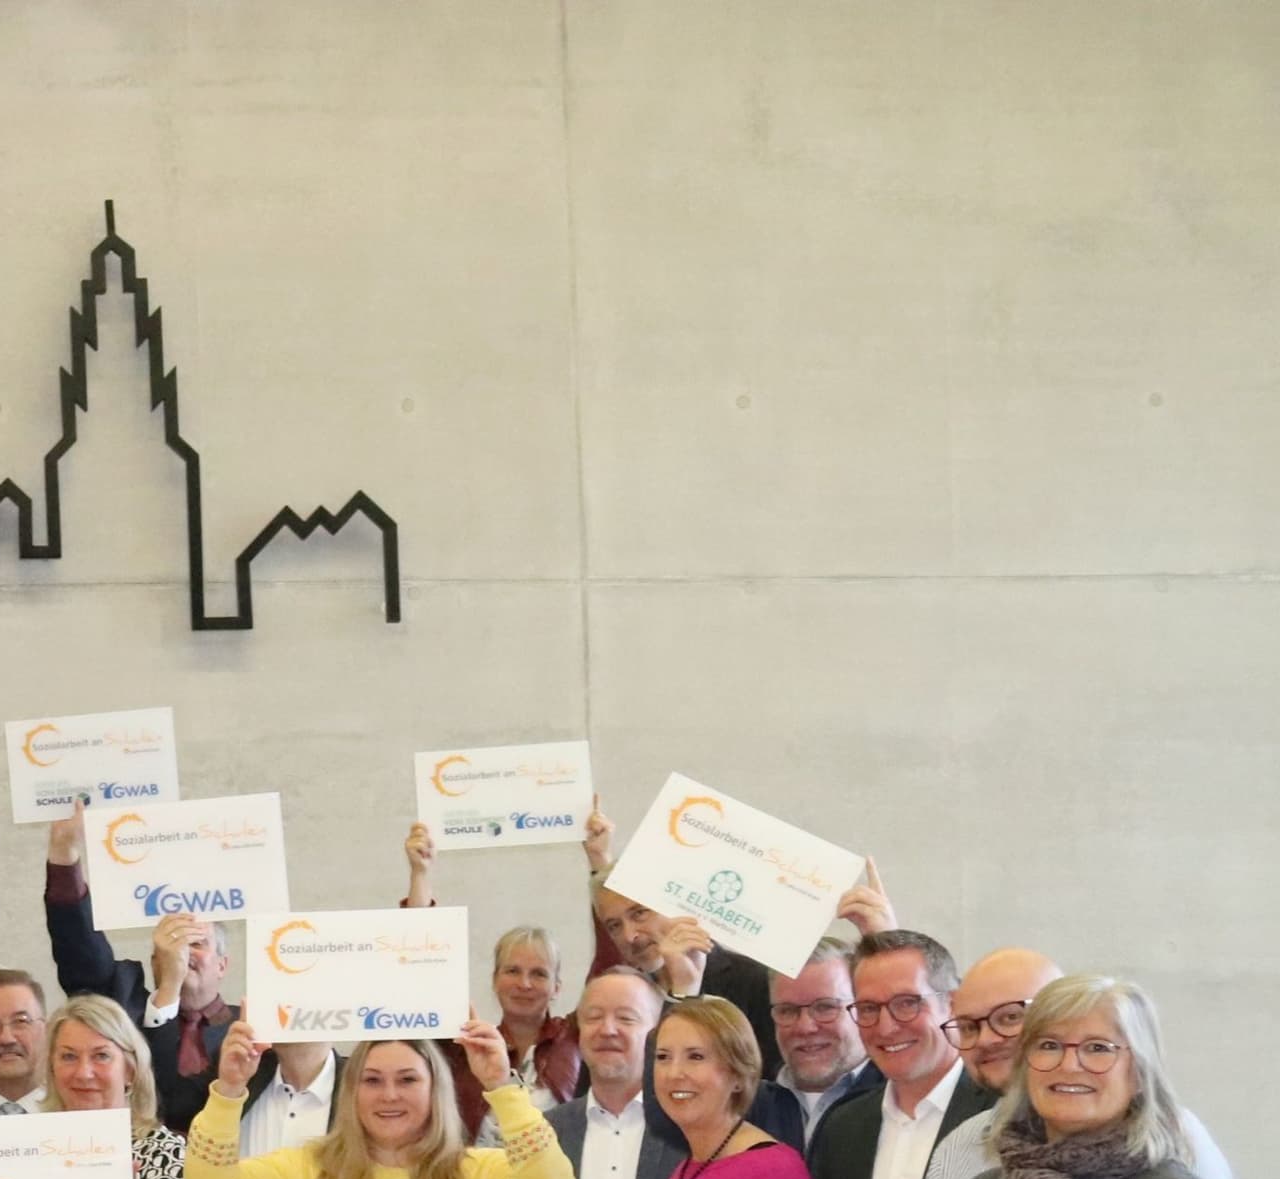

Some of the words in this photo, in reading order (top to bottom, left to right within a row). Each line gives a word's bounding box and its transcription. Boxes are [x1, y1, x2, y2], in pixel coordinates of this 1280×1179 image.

[112, 783, 159, 799] GWAB
[525, 814, 573, 829] GWAB
[115, 831, 181, 847] Sozialarbeit
[184, 830, 198, 840] an
[444, 825, 483, 836] SCHULE
[680, 812, 747, 850] Sozialarbeit
[748, 845, 764, 859] an
[160, 888, 245, 914] GWAB
[686, 891, 763, 935] ELISABETH
[279, 941, 353, 955] Sozialarbeit
[357, 941, 373, 952] an
[291, 1008, 352, 1031] KKS
[376, 1012, 440, 1030] GWAB
[23, 1146, 39, 1157] an
